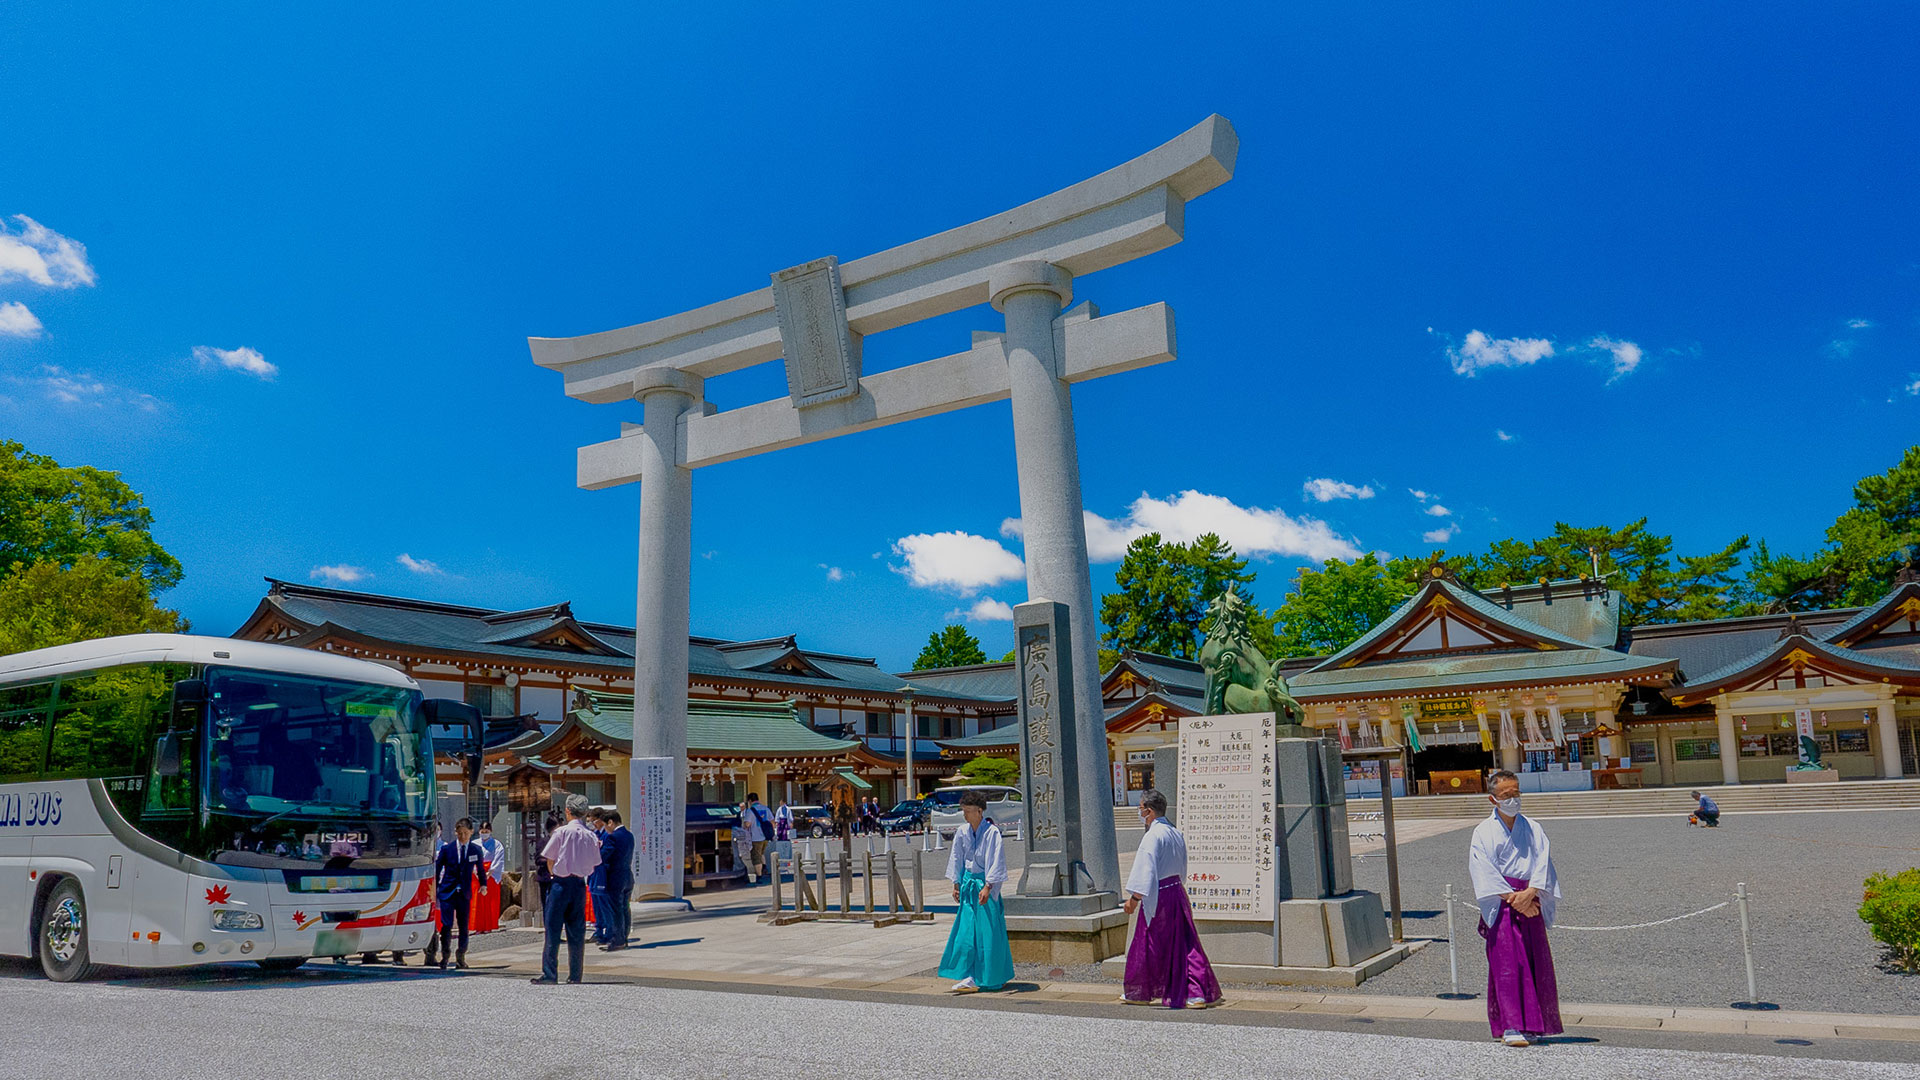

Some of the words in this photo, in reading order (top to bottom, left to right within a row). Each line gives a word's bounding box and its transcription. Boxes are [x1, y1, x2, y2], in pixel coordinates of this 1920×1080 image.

[1024, 633, 1059, 841] 廣島護國神社
[25, 790, 62, 826] BUS
[321, 832, 368, 843] ISUZU
